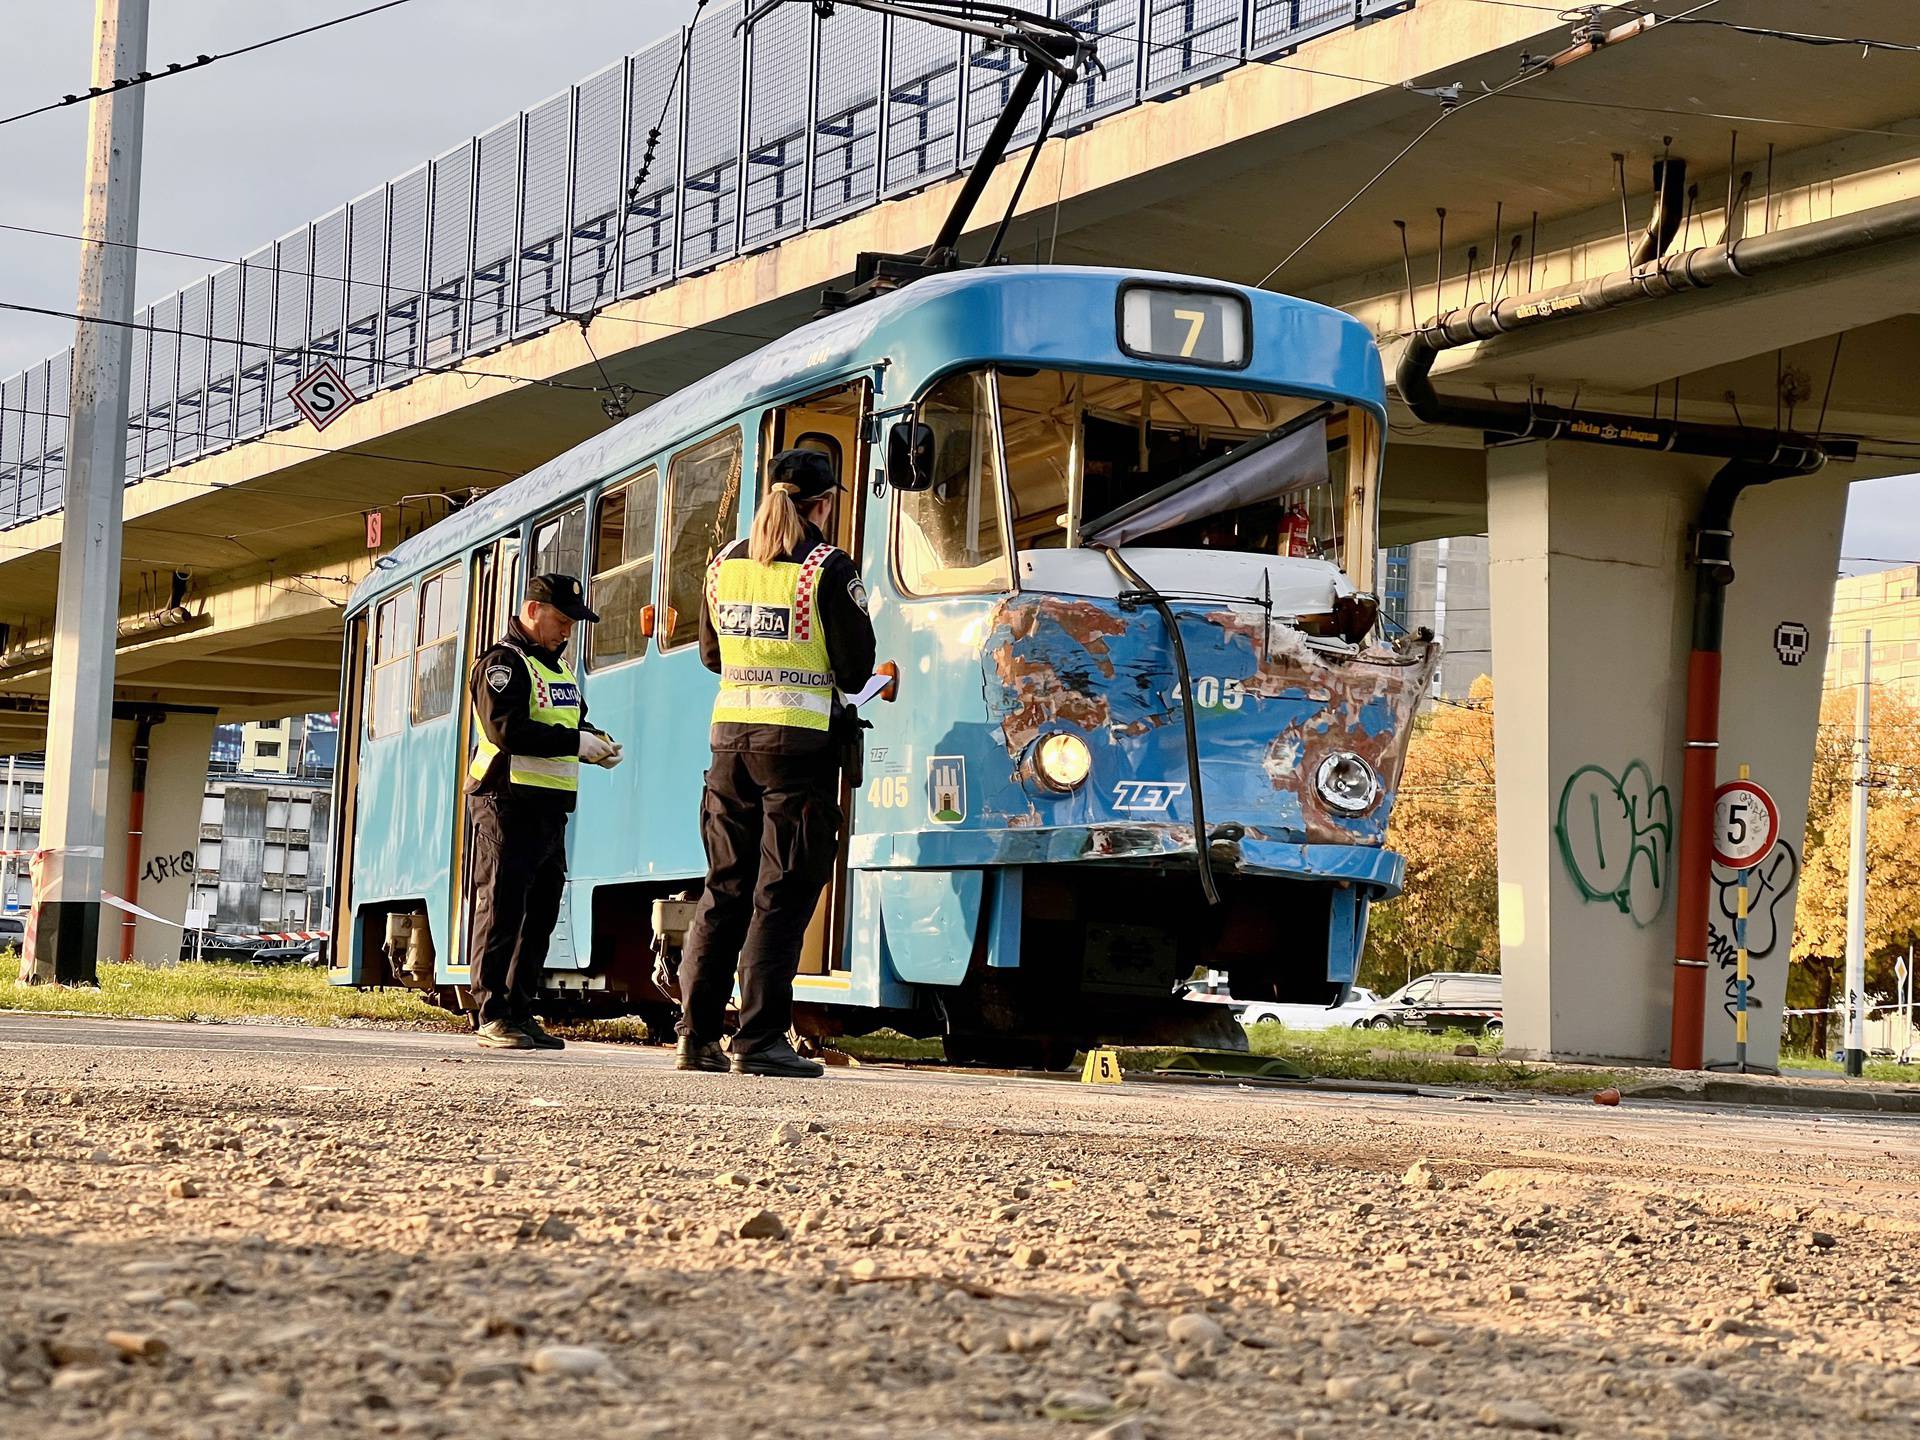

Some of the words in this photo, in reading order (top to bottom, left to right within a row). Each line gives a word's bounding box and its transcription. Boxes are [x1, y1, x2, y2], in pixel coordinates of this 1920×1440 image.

[1174, 309, 1204, 357] 7
[310, 381, 335, 412] S
[370, 518, 378, 544] S
[868, 776, 909, 808] 405
[1112, 780, 1187, 811] ZET
[1727, 804, 1748, 845] 5
